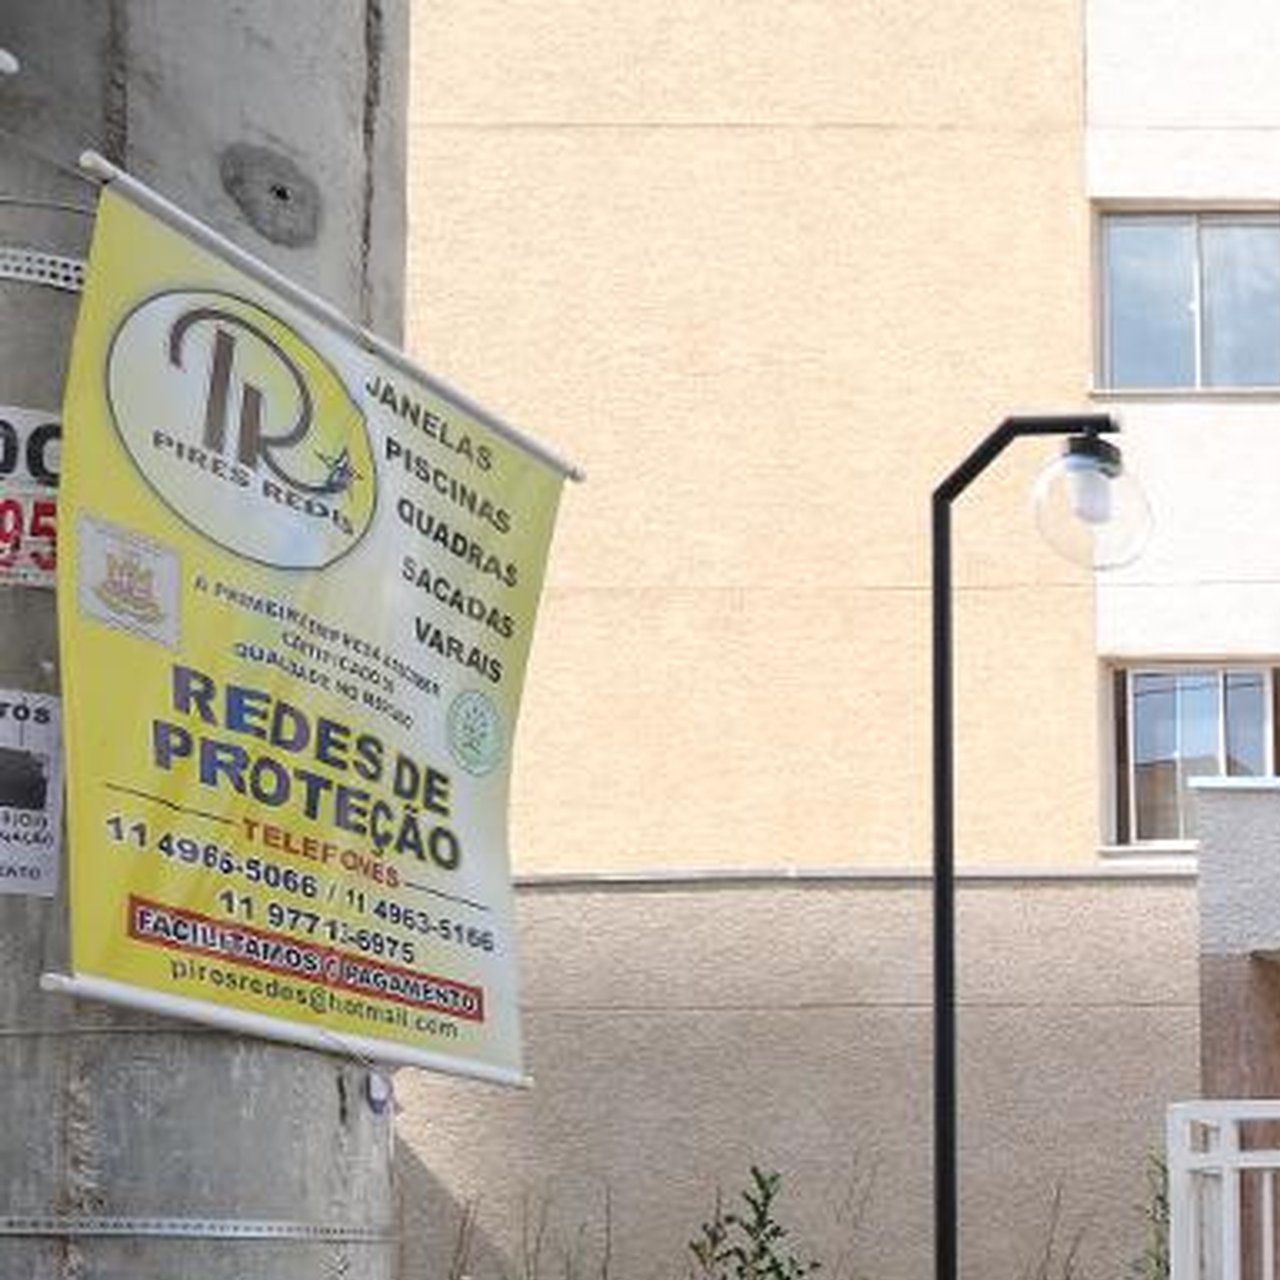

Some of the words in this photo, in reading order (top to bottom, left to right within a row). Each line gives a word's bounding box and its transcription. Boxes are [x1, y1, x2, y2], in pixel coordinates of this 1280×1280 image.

[153, 430, 251, 487] PIRES
[366, 376, 492, 471] JANELAS
[386, 436, 511, 534] PISCINAS
[398, 498, 517, 588] QUADRAS
[402, 556, 514, 638] SACADAS
[415, 616, 503, 684] VARAIS
[172, 664, 384, 782] REDES
[393, 753, 450, 817] DE
[152, 720, 461, 871] PROTEÇÃO
[106, 816, 147, 847] 11
[347, 889, 365, 914] 11
[242, 818, 399, 888] TELEFONES
[139, 909, 318, 971] FACILITAMOS
[220, 890, 255, 920] 11
